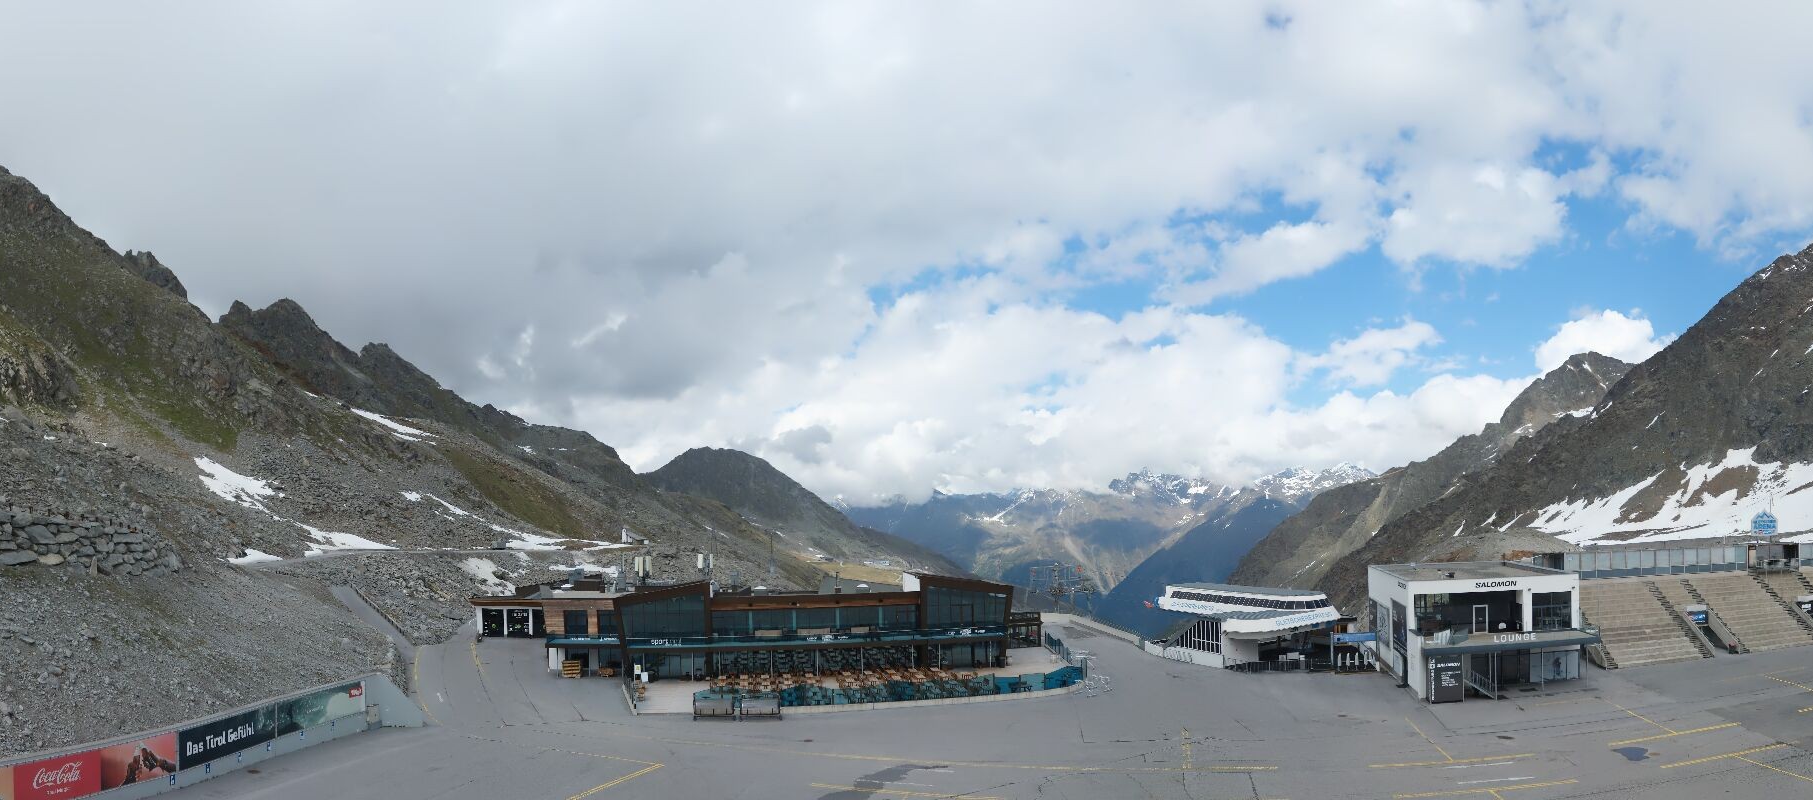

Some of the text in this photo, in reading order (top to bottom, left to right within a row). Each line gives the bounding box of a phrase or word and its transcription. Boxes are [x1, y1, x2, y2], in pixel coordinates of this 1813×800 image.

[1475, 580, 1517, 589] SALOMON
[1493, 632, 1537, 643] LOUNGE
[186, 722, 255, 757] Das Tirol Gefühl
